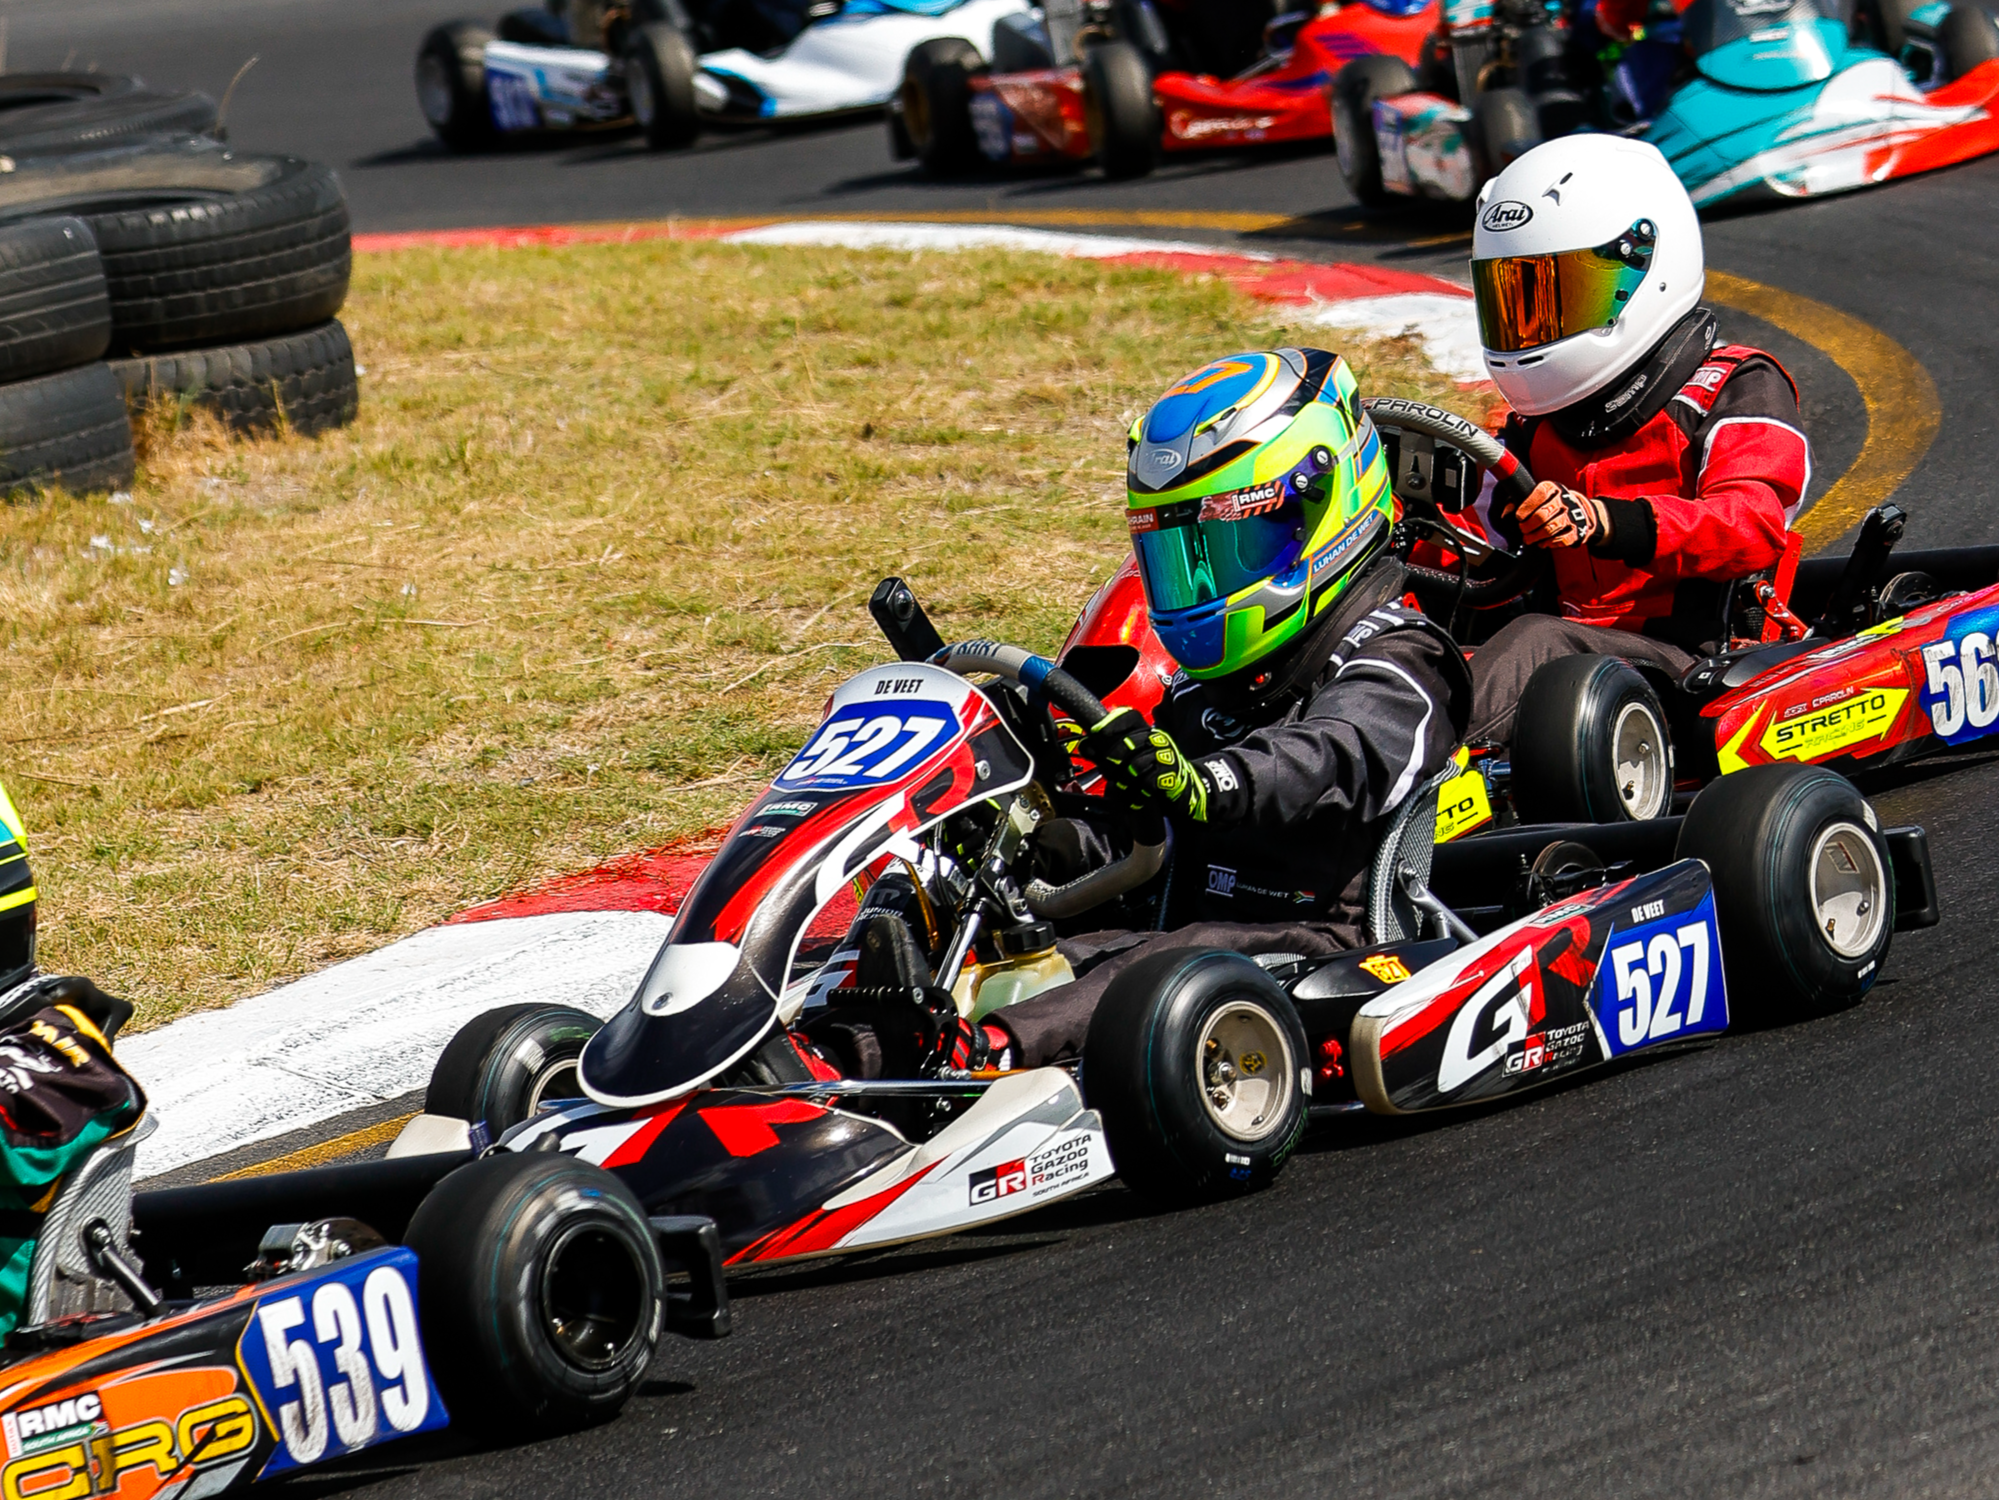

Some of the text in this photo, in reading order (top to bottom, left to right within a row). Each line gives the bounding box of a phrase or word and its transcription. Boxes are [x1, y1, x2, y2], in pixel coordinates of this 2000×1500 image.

[1484, 204, 1526, 224] Arai
[1373, 399, 1478, 438] PAROLIN
[1239, 488, 1275, 504] RMC
[1313, 514, 1374, 573] LUHAN DE WET
[874, 679, 924, 695] DE VEET
[1921, 631, 2000, 736] 56
[1776, 694, 1885, 743] STRETTO
[782, 715, 946, 781] 527
[1805, 719, 1865, 748] RACING
[1209, 870, 1236, 892] OMP
[1631, 899, 1665, 923] DE VEET
[1611, 920, 1710, 1046] 527
[1547, 1021, 1590, 1041] TOYOTA
[1506, 1045, 1543, 1074] GR
[1029, 1134, 1092, 1163] TOYOTA
[1030, 1147, 1088, 1175] GAZOO
[970, 1169, 1026, 1204] GR
[1032, 1158, 1088, 1186] Racing
[1032, 1171, 1090, 1197] SOUTH AFRICA
[257, 1265, 430, 1464] 539
[18, 1393, 102, 1439] RMC
